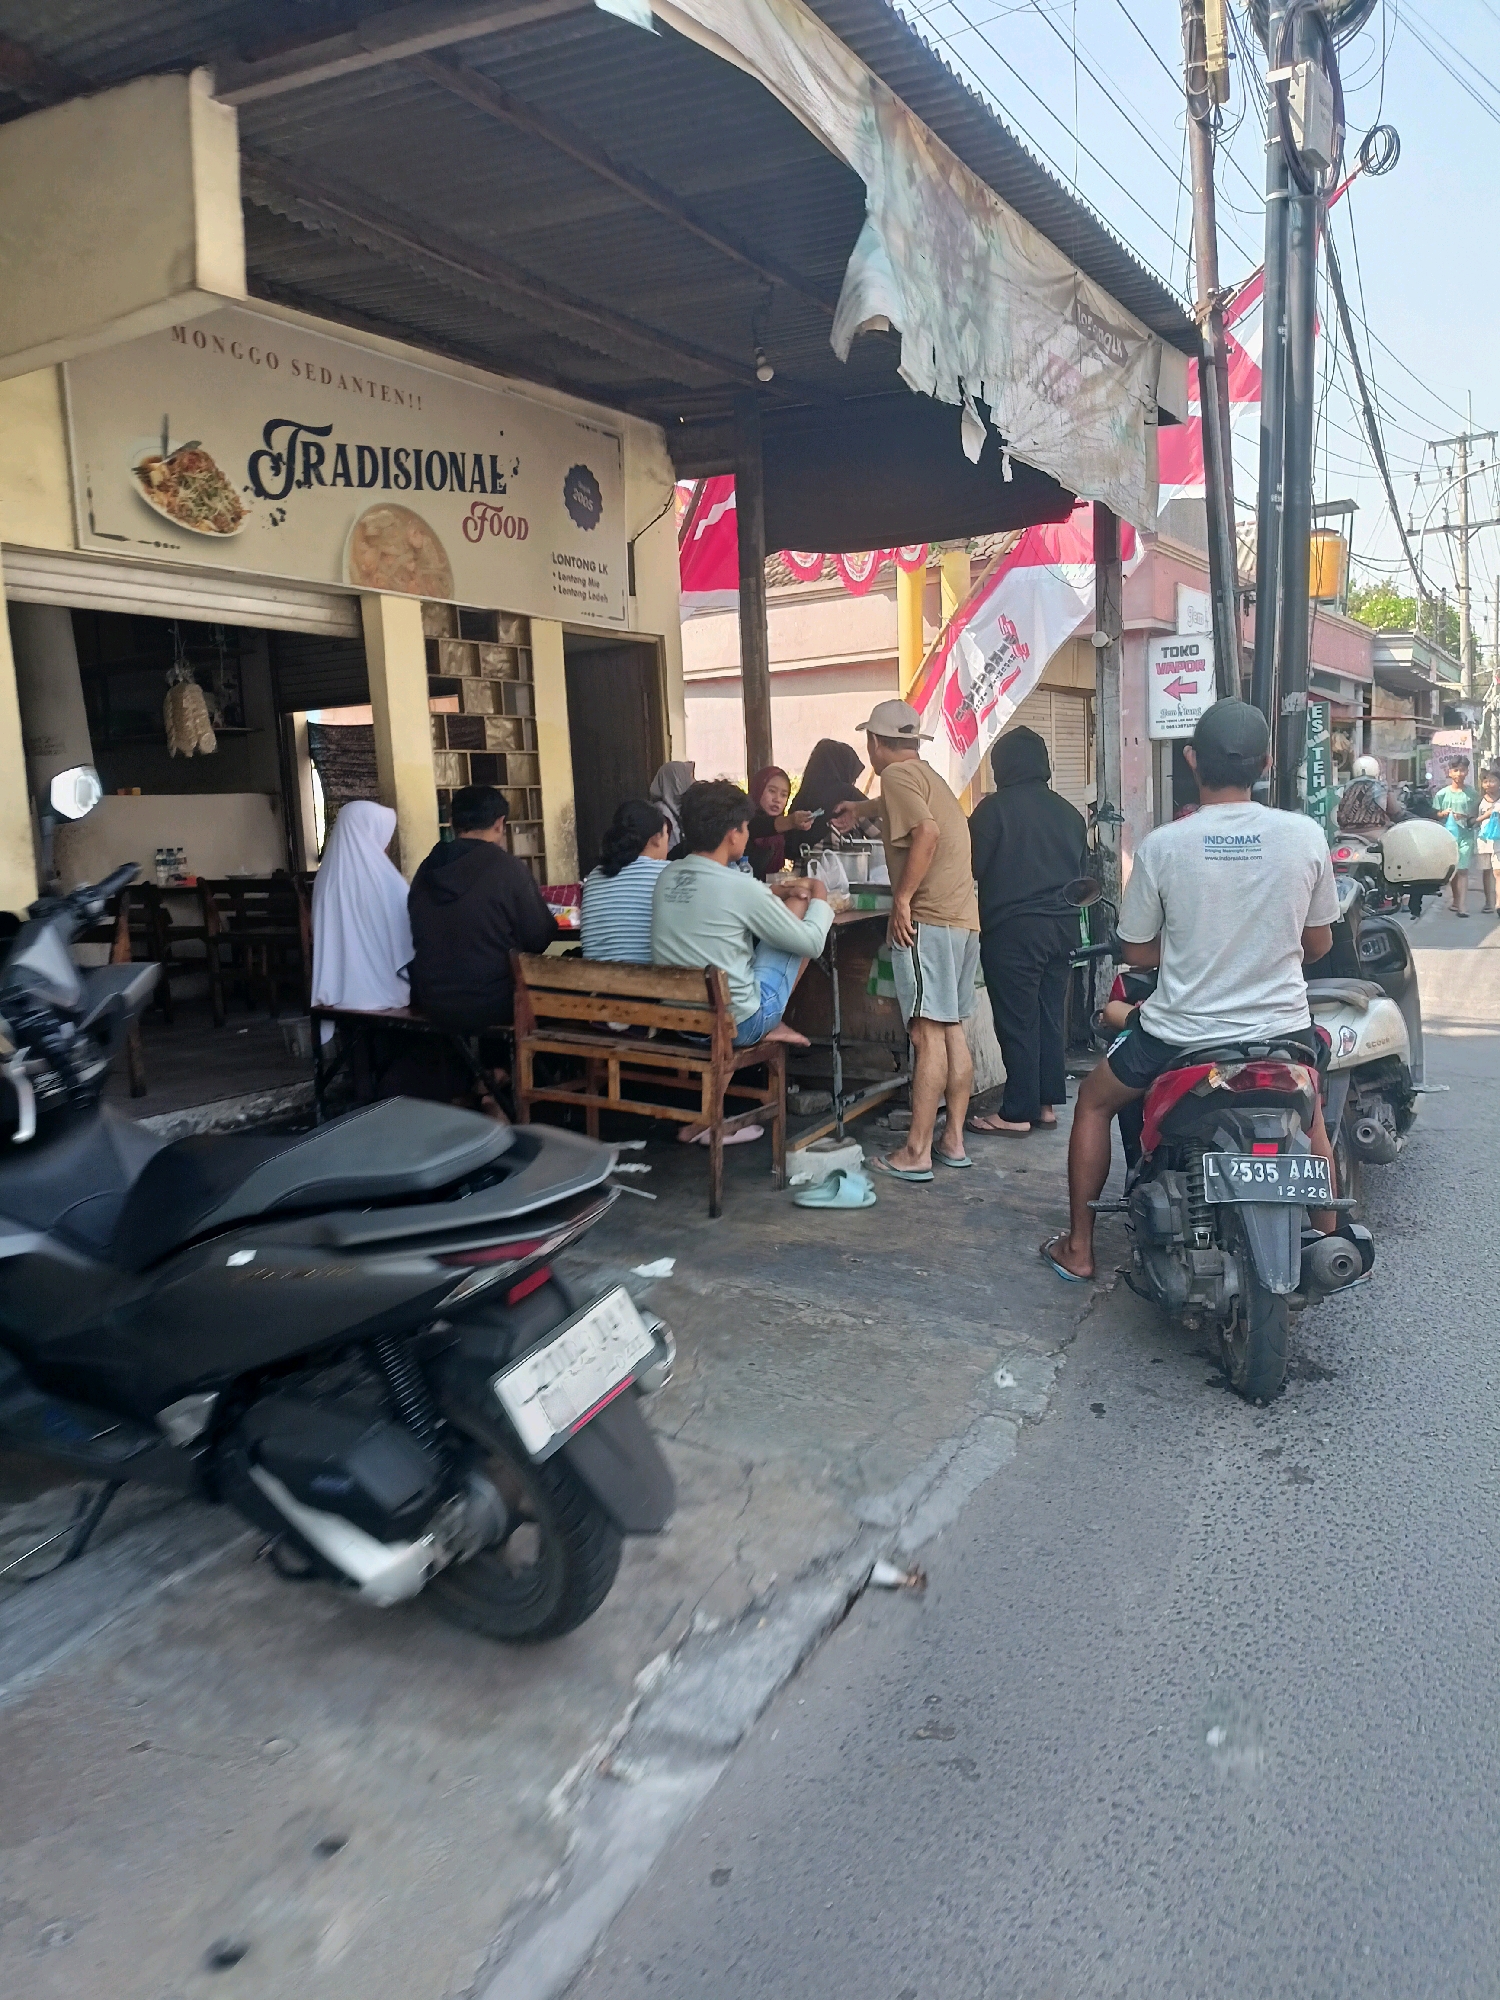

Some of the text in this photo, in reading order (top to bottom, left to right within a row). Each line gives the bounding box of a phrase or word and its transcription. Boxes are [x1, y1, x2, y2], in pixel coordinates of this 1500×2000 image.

[171, 325, 422, 411] MONGGO SEDANTEN!!
[248, 418, 507, 501] TRADISIONAL
[573, 487, 594, 512] 2005
[462, 501, 529, 543] FOOD
[552, 551, 608, 575] LONTONG LK
[1161, 644, 1199, 658] TOKO
[1155, 659, 1206, 675] VAPOR
[1311, 705, 1324, 732] ES
[1312, 747, 1326, 787] TEH
[1203, 834, 1261, 844] INDOMAK
[1208, 1158, 1326, 1183] L 2535 AAK
